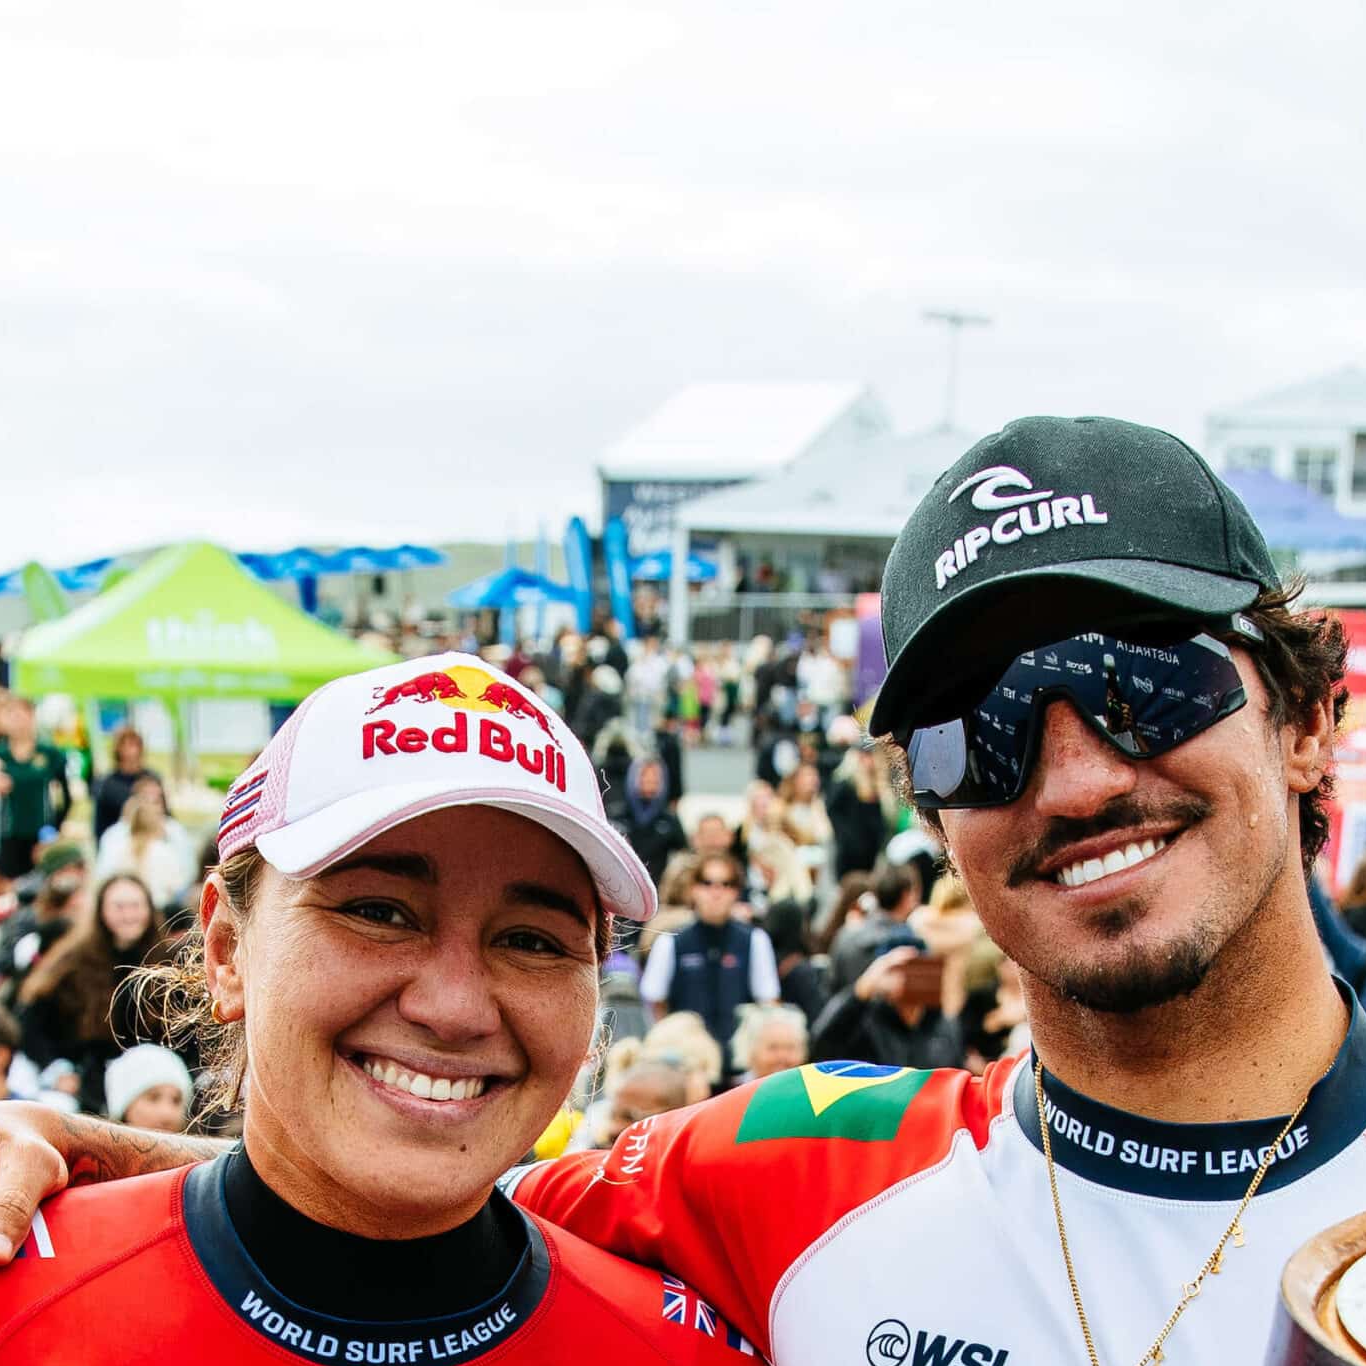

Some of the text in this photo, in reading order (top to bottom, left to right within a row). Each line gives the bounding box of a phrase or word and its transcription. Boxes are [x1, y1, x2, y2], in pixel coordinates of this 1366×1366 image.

[362, 711, 566, 792] Red Bull
[1037, 1090, 1116, 1157] WORLD
[1119, 1139, 1198, 1174] SURF
[239, 1289, 518, 1365] WORLD SURF LEAGUE
